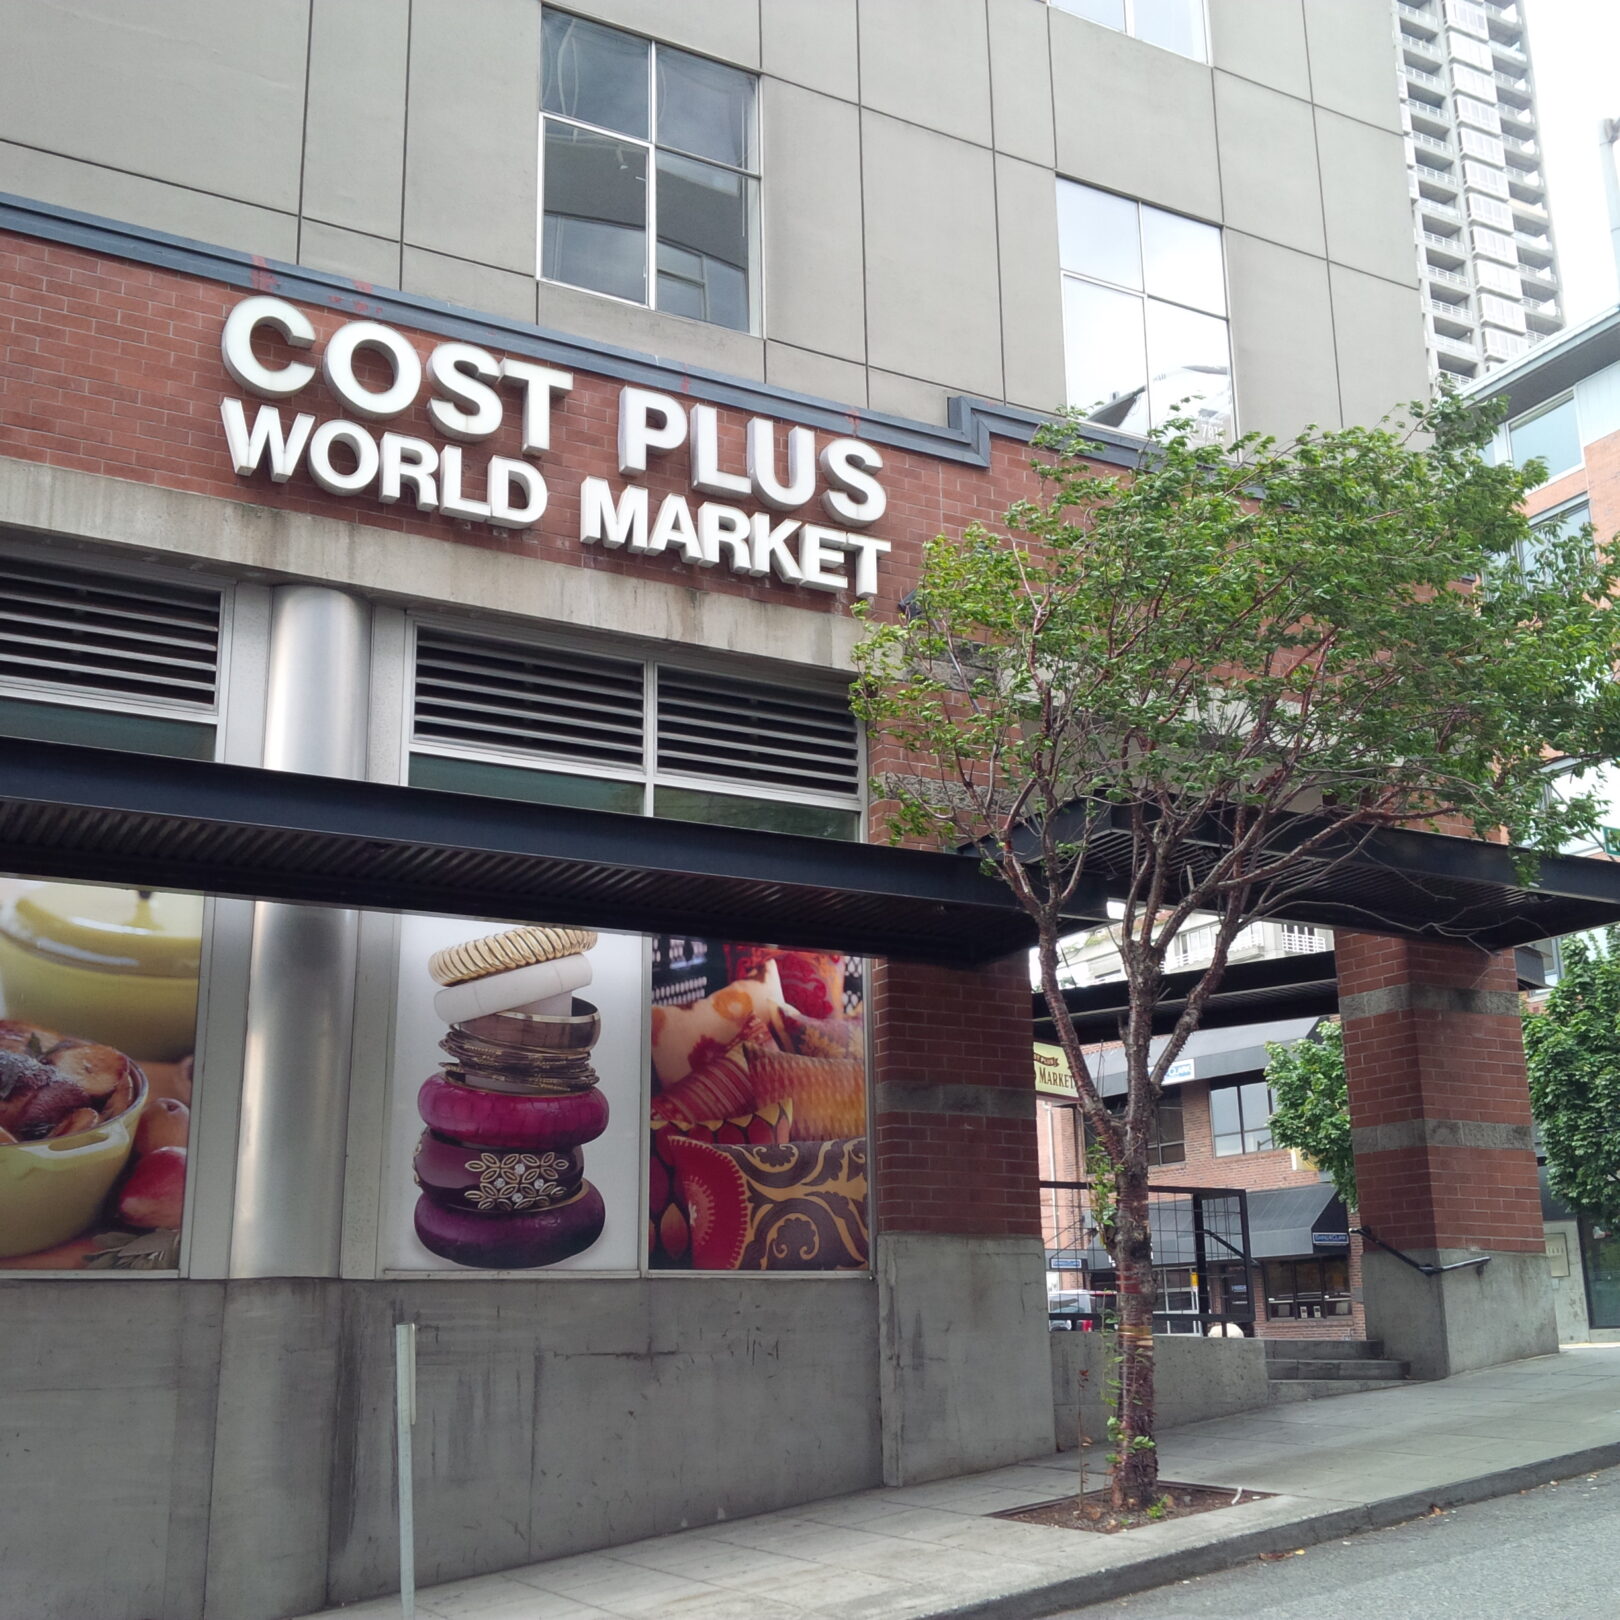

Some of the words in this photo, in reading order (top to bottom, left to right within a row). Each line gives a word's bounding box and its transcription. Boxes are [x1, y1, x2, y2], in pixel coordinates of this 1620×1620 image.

[220, 397, 548, 530] WORLD
[579, 475, 892, 598] MARKET
[221, 295, 573, 456] COST
[618, 385, 888, 528] PLUS
[1039, 1067, 1075, 1089] MARKET
